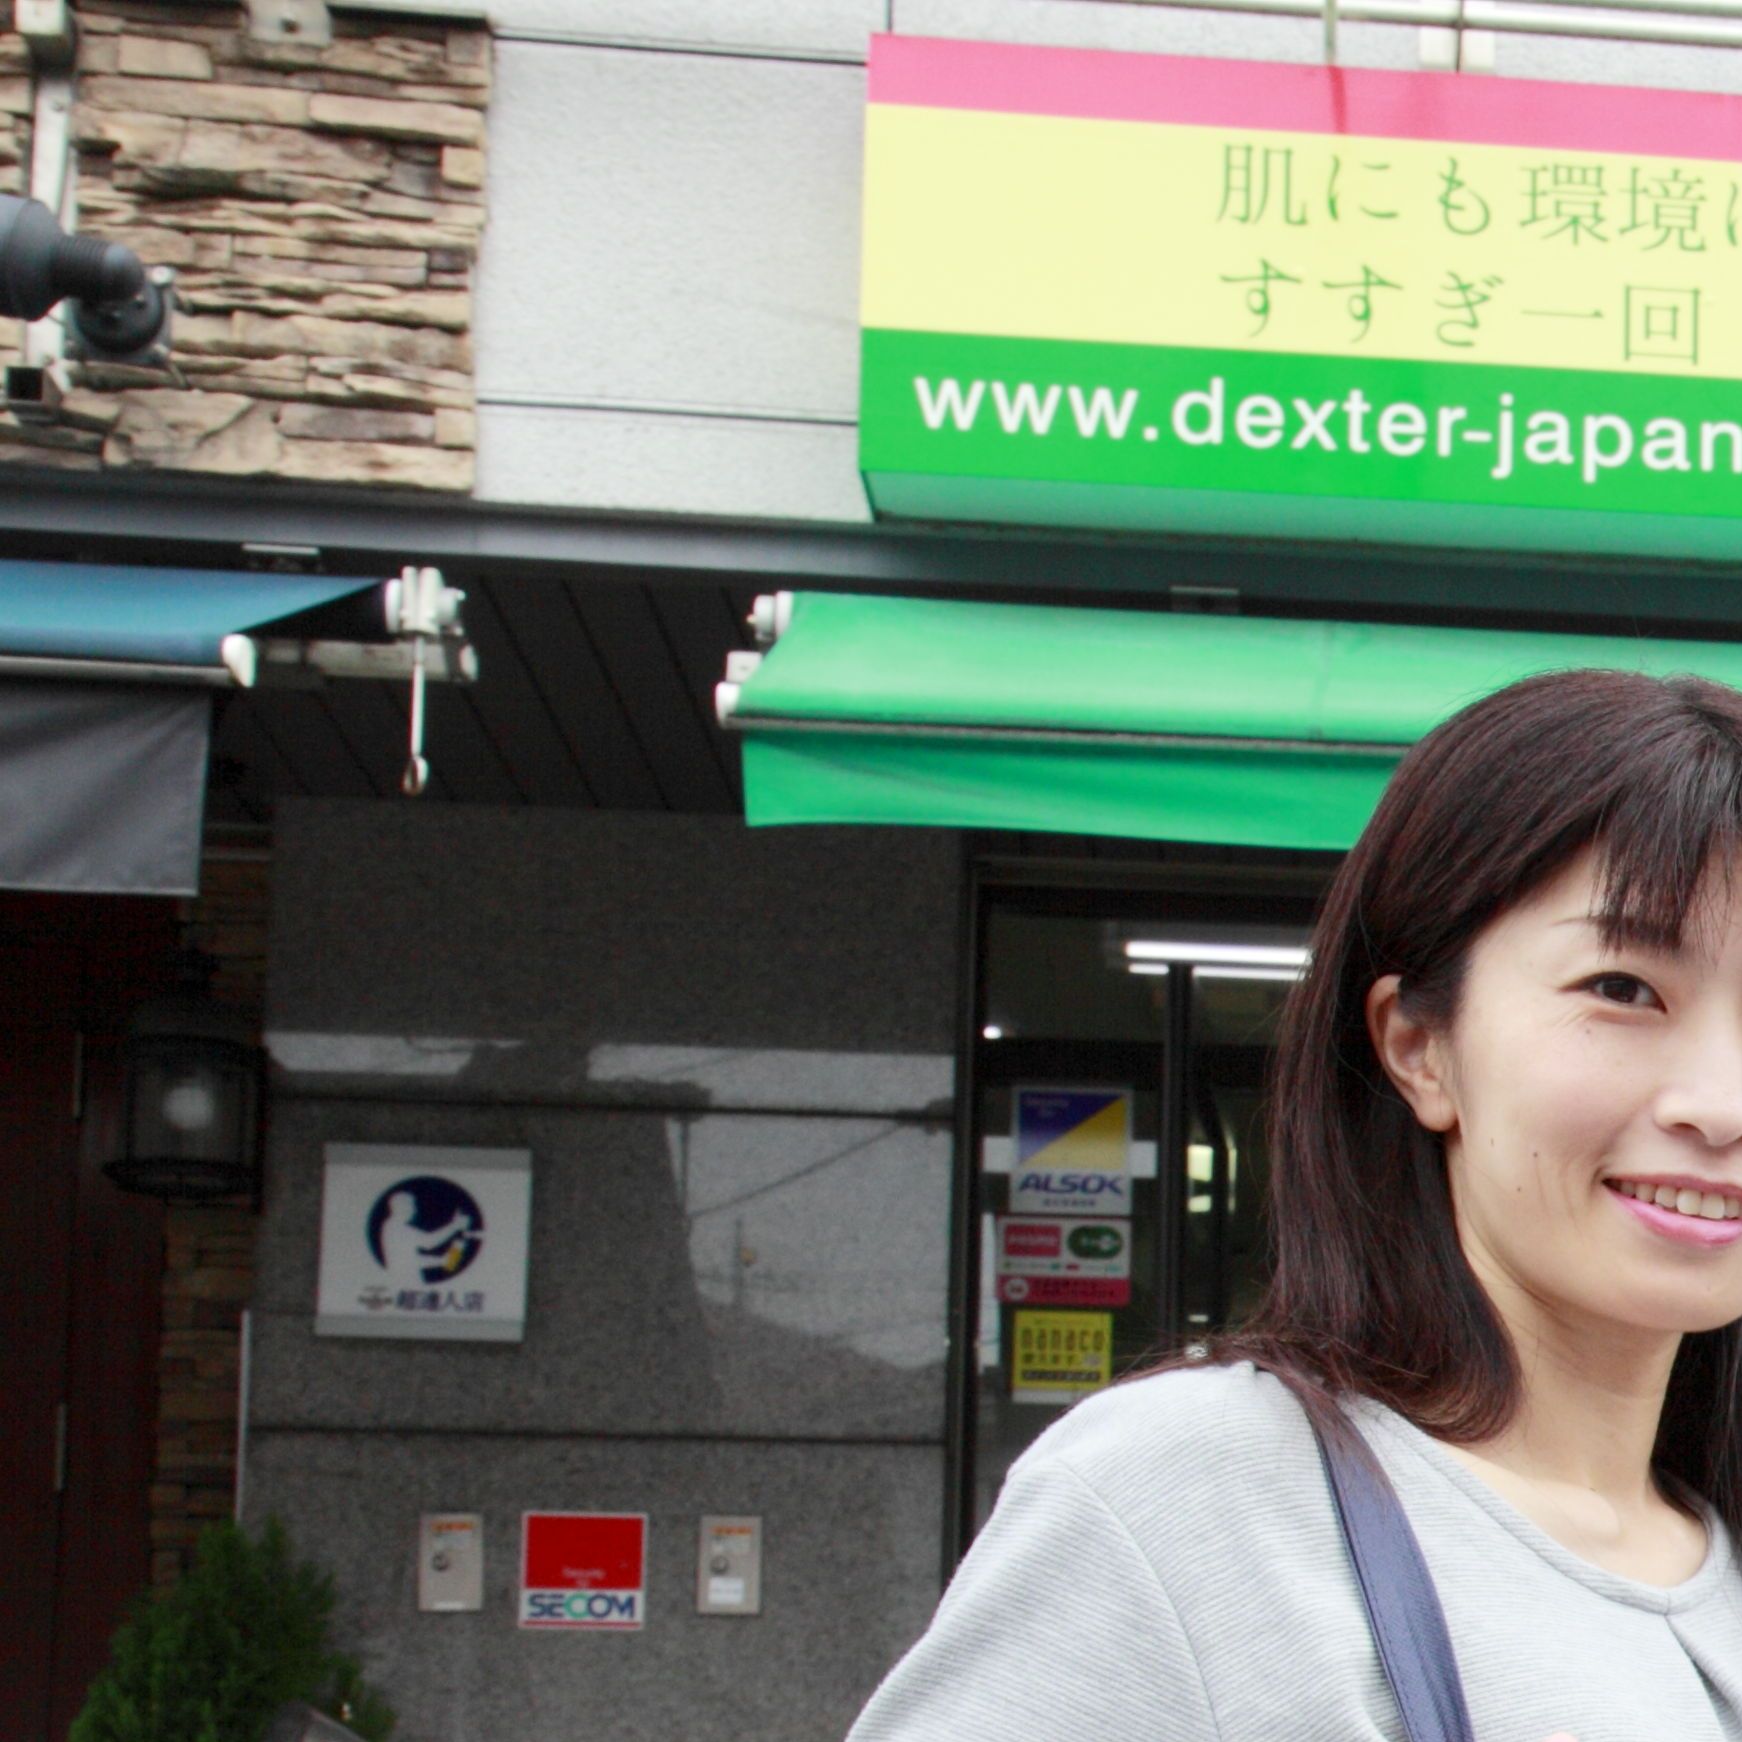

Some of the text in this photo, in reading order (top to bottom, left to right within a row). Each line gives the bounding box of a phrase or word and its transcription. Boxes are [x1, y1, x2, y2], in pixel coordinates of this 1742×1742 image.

[1218, 258, 1704, 367] すすぎ一回
[1019, 1173, 1123, 1196] ALSOK
[528, 1592, 636, 1619] SECOM
